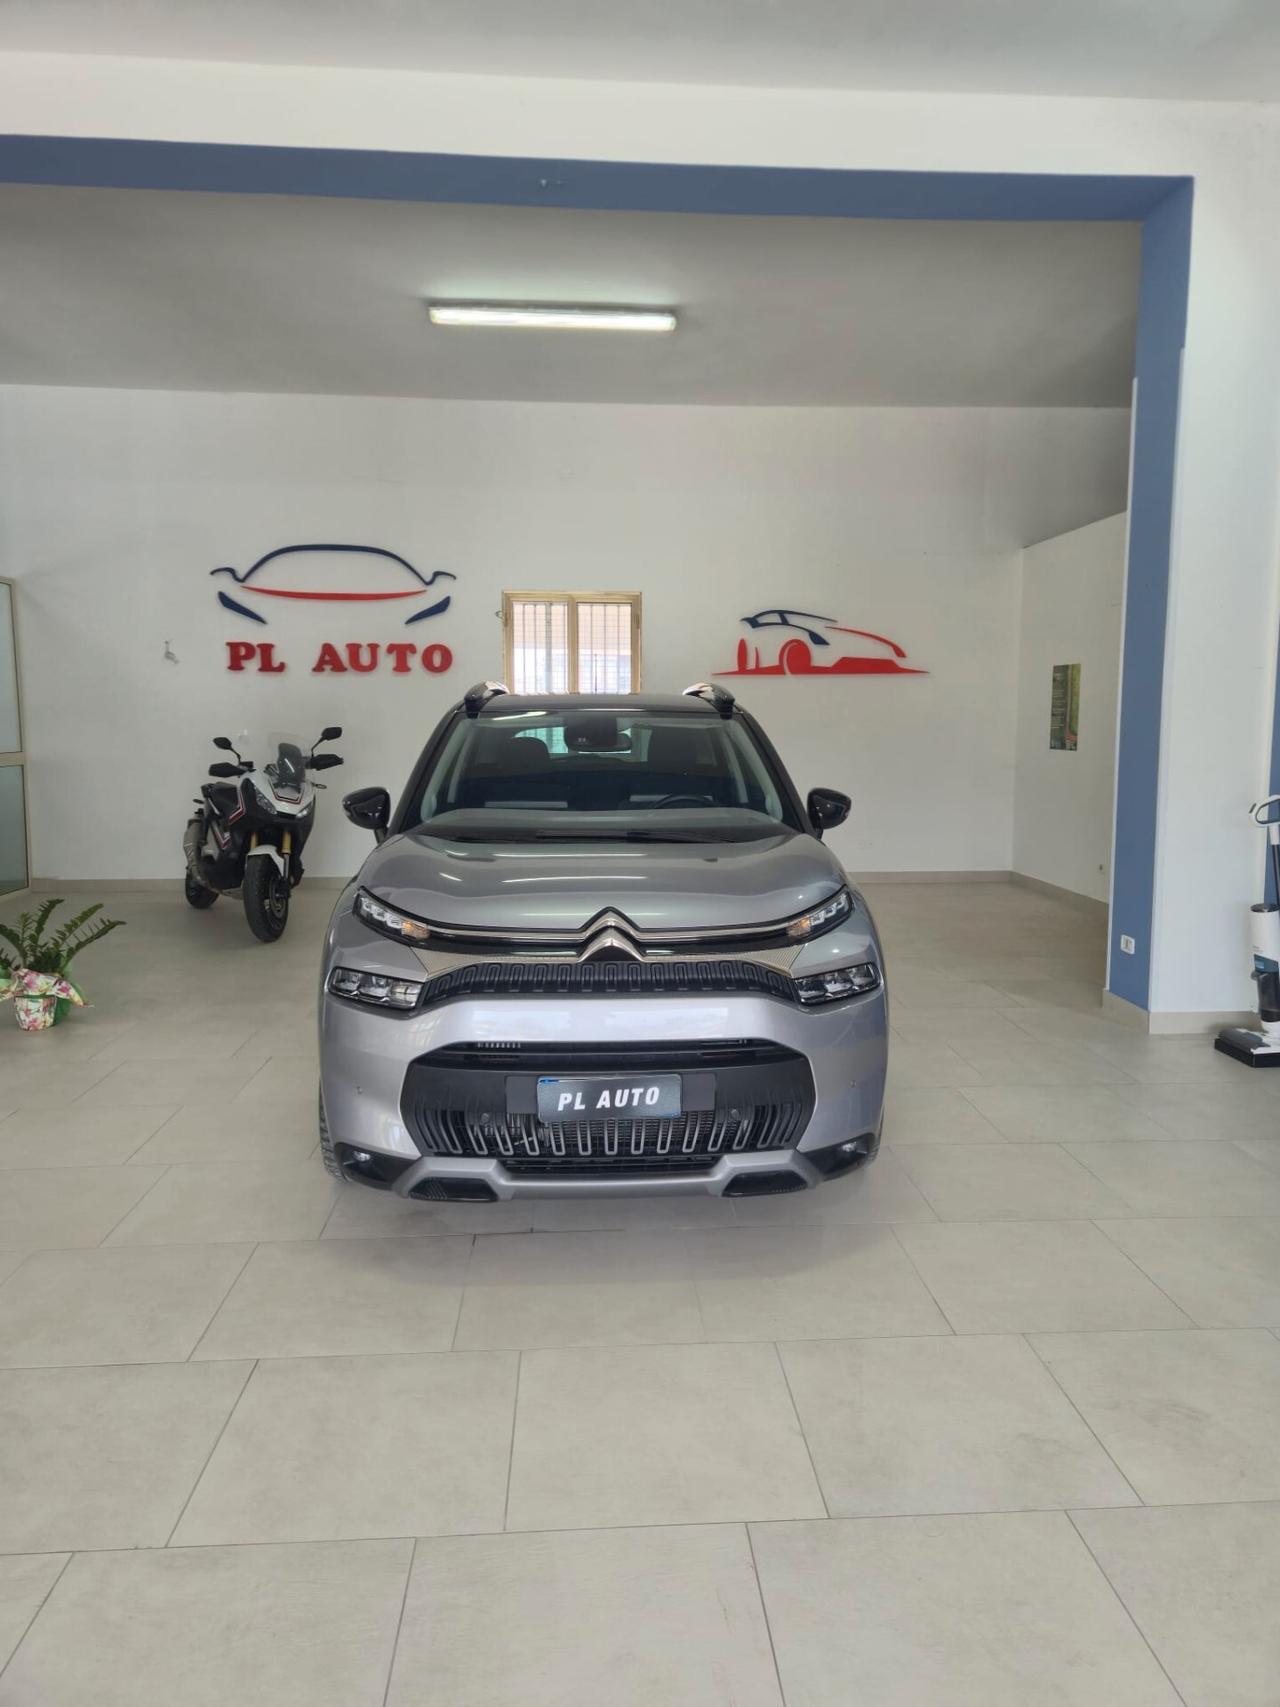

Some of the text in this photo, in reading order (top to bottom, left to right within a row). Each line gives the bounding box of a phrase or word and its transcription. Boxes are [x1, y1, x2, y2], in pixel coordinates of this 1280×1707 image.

[225, 641, 453, 673] PL AUTO
[557, 1086, 660, 1111] PL AUTO
